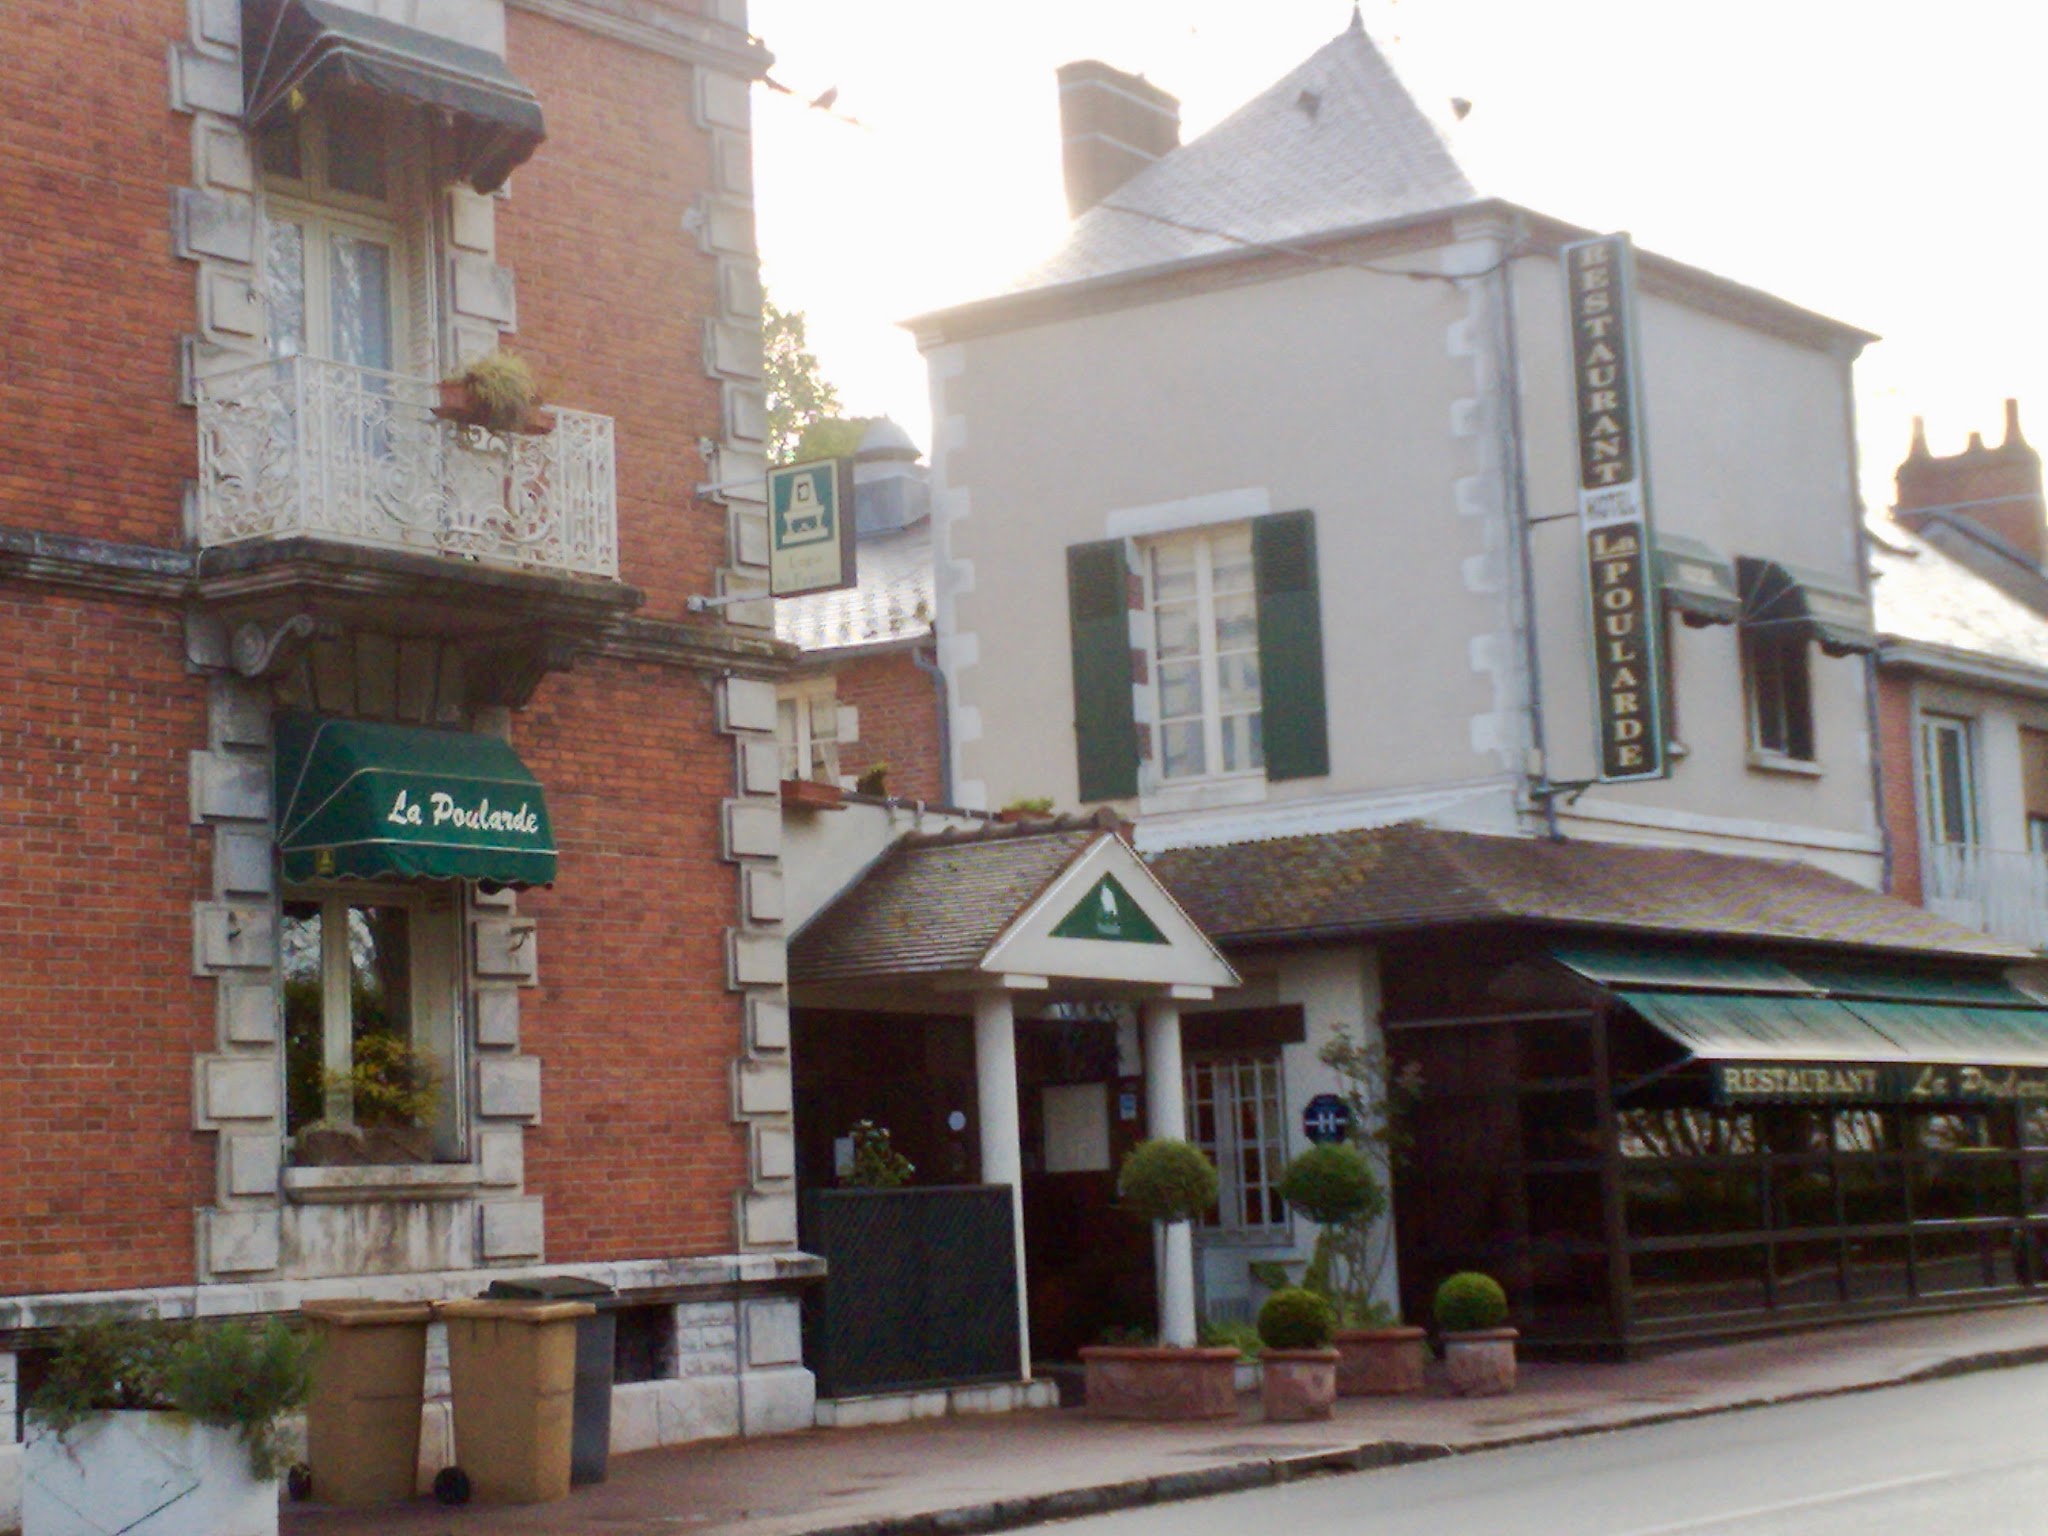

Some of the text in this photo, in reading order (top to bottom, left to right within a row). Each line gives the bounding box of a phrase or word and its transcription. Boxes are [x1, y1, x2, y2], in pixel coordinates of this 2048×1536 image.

[1578, 244, 1624, 485] RESTAURANT
[1602, 560, 1643, 768] POULARDE
[387, 788, 540, 834] La Poularde
[1723, 1067, 1877, 1094] RESTAURANT
